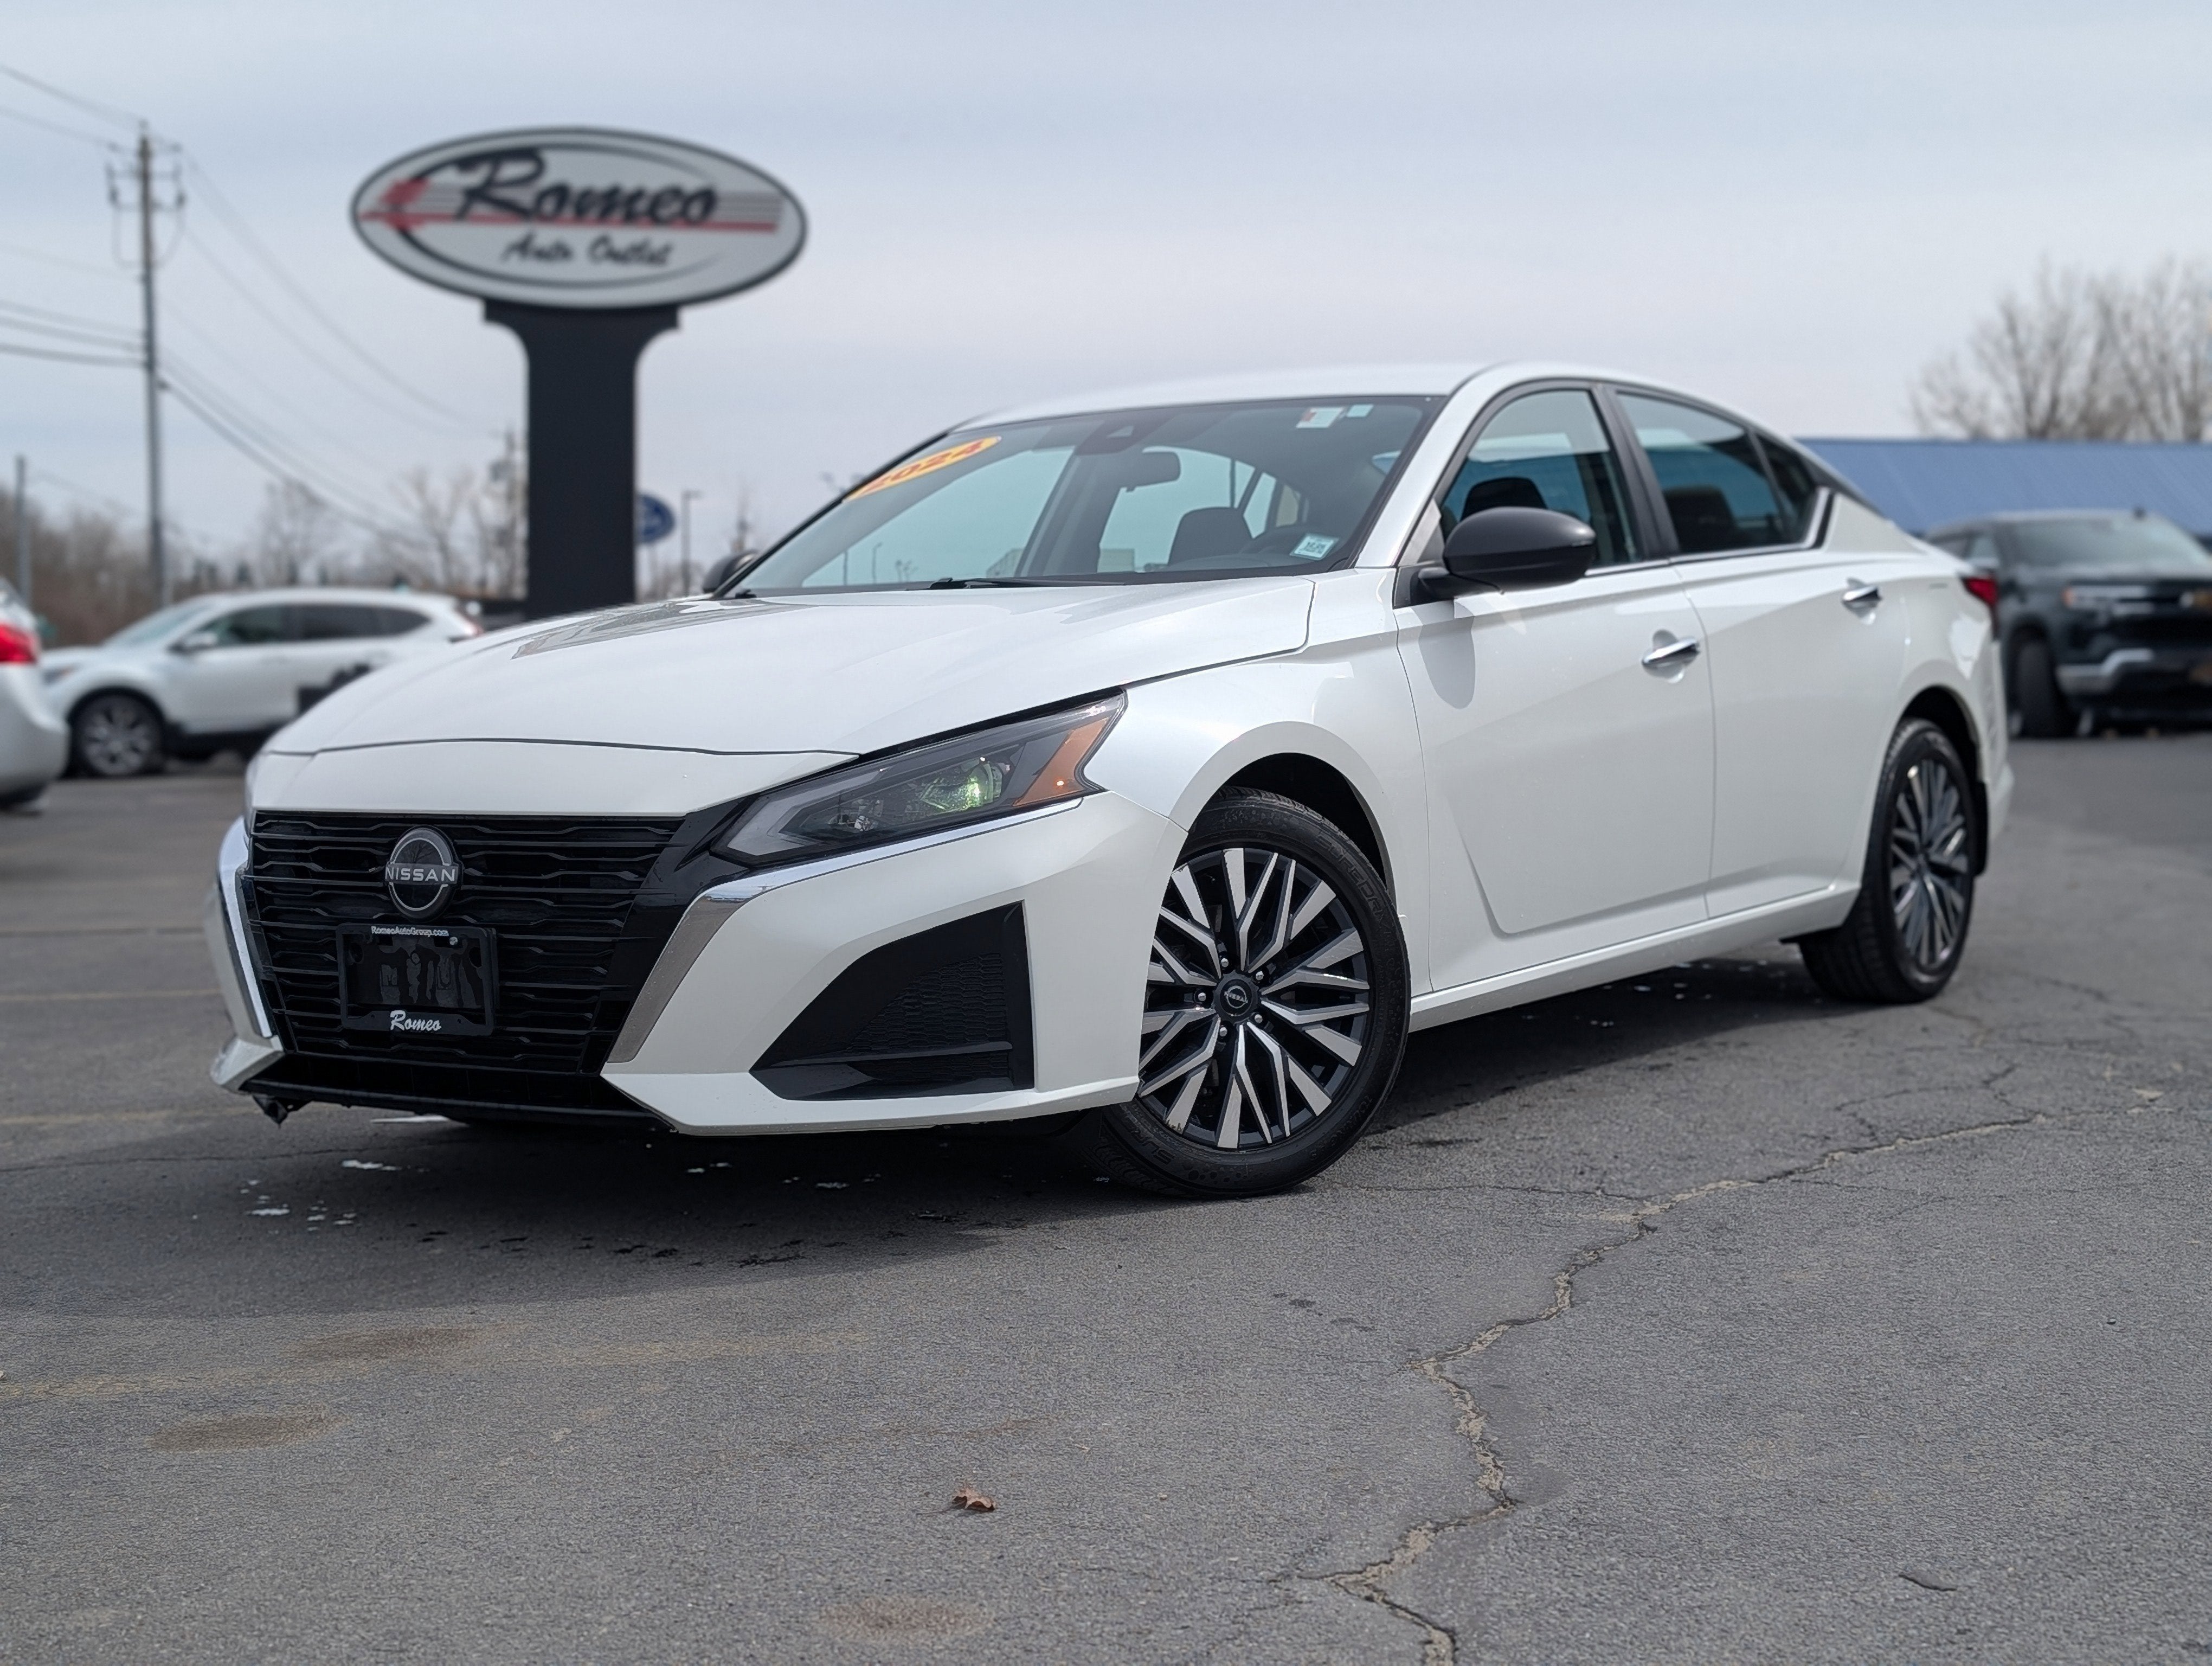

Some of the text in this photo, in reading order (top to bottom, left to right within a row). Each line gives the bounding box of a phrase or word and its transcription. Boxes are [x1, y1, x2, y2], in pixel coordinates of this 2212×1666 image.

[452, 146, 718, 225] Romeo
[500, 231, 673, 266] Auto Outlet
[385, 867, 455, 882] NISSAN
[370, 925, 449, 938] RomeoAutoGroup.com
[390, 1010, 442, 1031] Romeo
